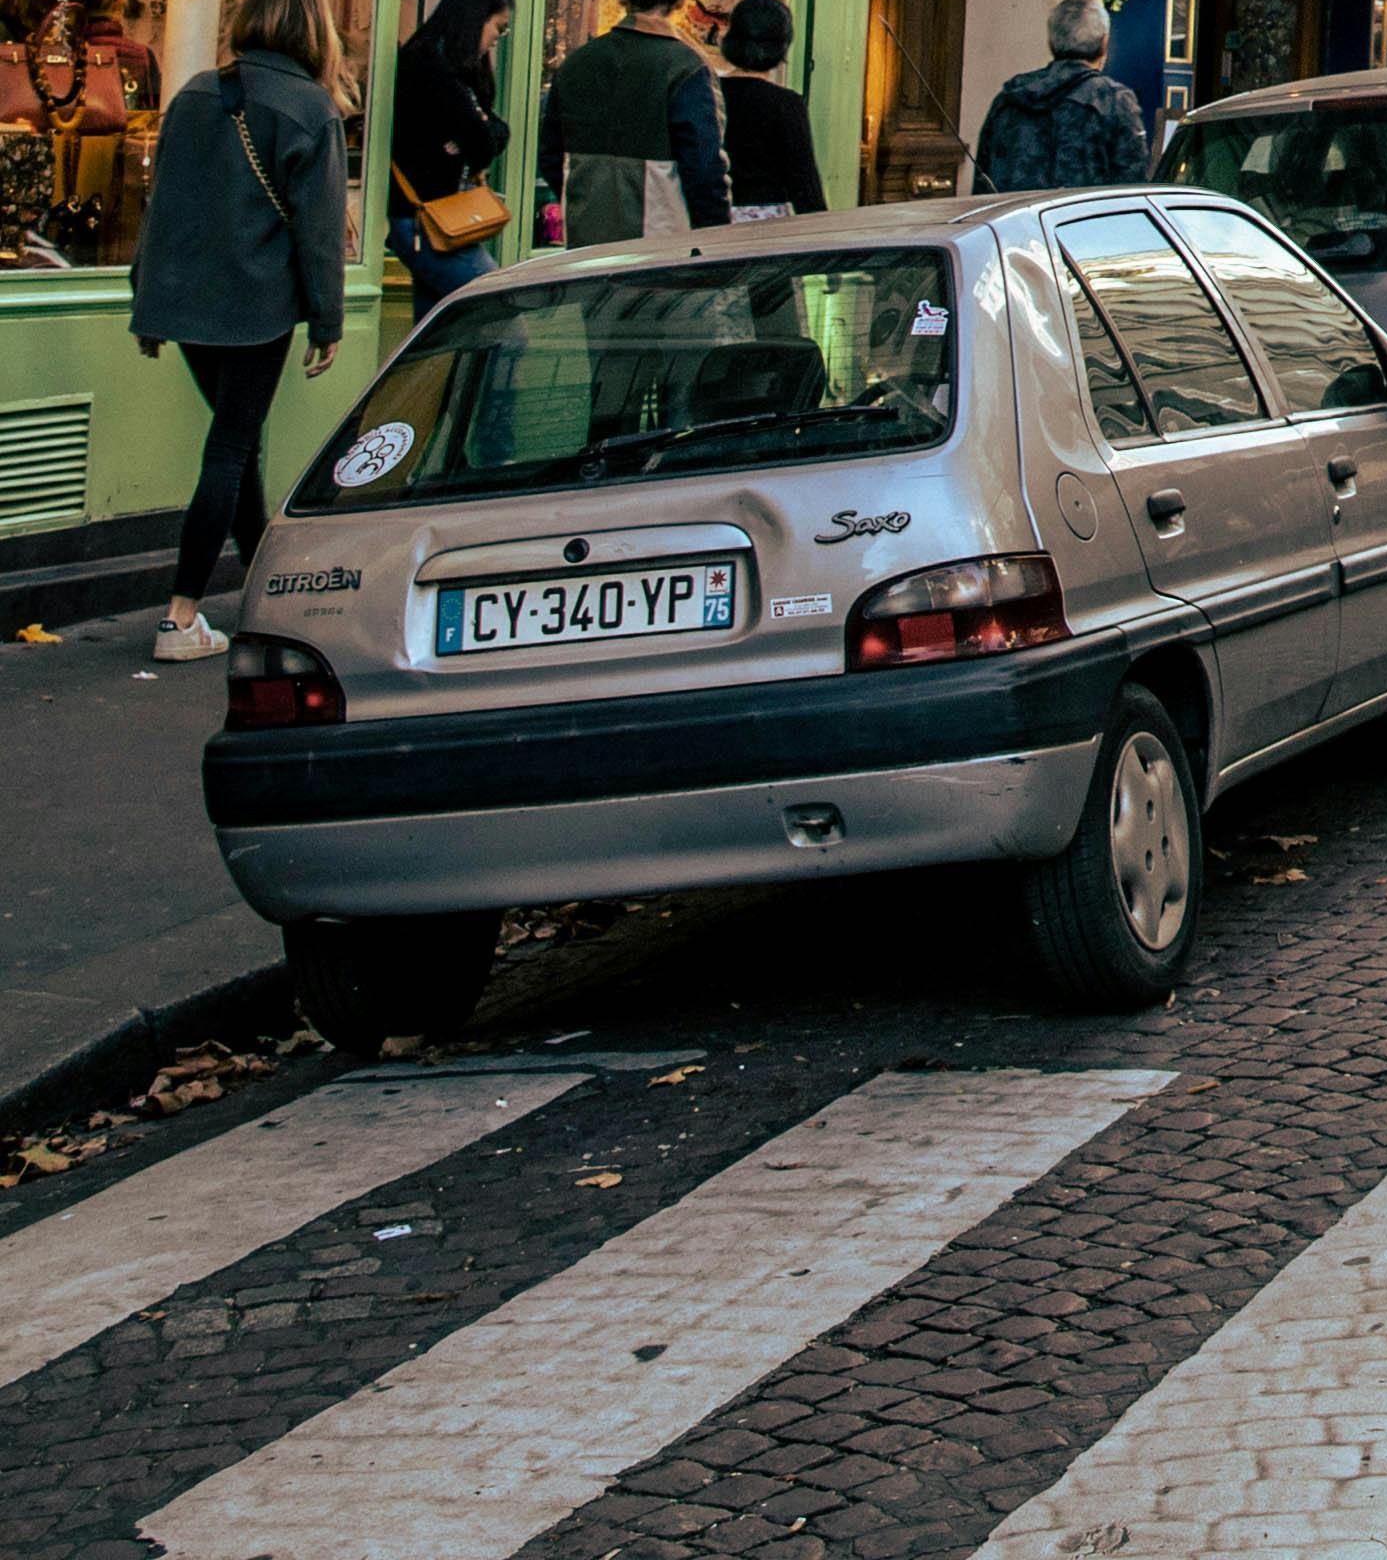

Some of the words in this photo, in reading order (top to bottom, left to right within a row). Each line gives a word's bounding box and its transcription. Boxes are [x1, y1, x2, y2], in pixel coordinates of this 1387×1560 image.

[814, 510, 911, 544] Saxo
[266, 567, 361, 595] CITROËN
[445, 627, 455, 643] F
[473, 574, 695, 642] CY-340-YP
[705, 597, 729, 622] 75
